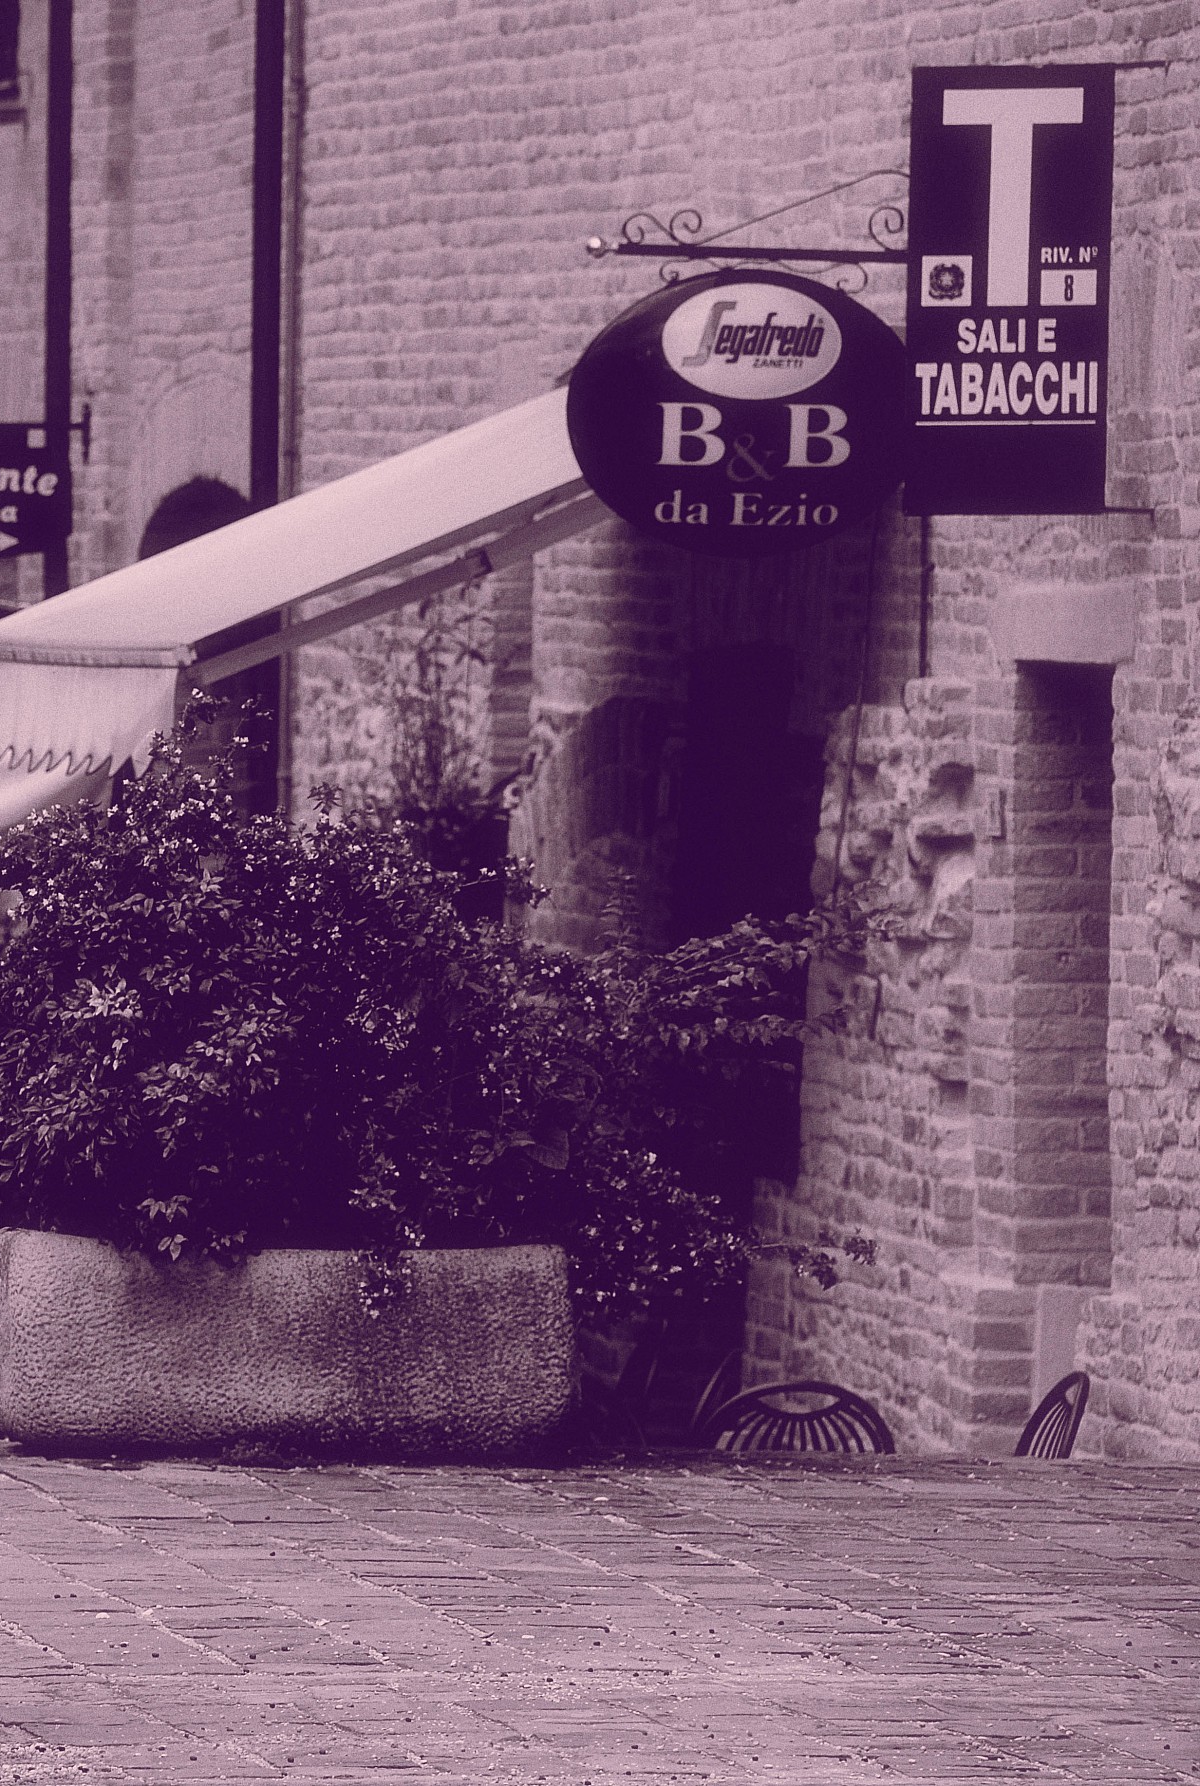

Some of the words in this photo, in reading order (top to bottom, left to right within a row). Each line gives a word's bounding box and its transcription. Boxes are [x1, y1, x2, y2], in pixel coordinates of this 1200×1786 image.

[943, 87, 1084, 307] T
[1041, 246, 1073, 264] RIV.
[1064, 274, 1074, 302] 8
[957, 318, 1026, 354] SALI
[1037, 318, 1057, 353] E
[752, 358, 804, 370] ZANETTI
[915, 360, 1098, 416] TABACCHI
[654, 489, 710, 525] da
[729, 493, 839, 526] Ezio
